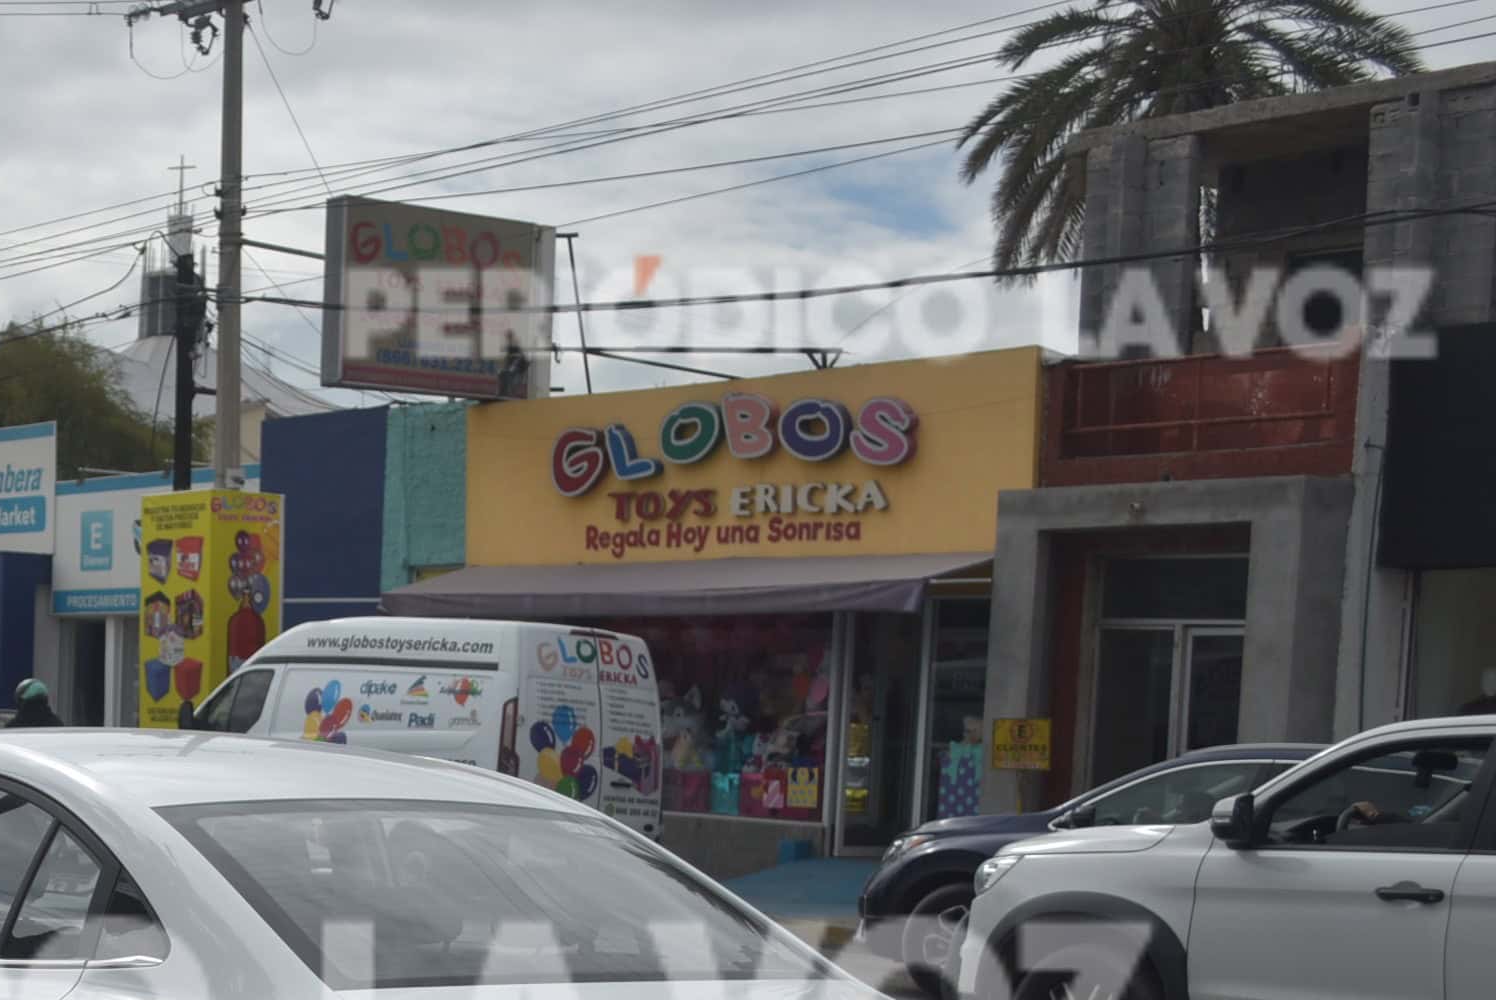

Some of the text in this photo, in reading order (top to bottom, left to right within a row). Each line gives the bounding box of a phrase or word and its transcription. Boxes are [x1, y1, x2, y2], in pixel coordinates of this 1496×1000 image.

[552, 392, 917, 498] GLOBOS
[609, 480, 889, 522] TOYS ERICKA
[586, 517, 862, 559] Regala Hoy una Sonrisa
[306, 634, 494, 655] www.globostoysericka.com
[536, 637, 650, 679] GLOBOS
